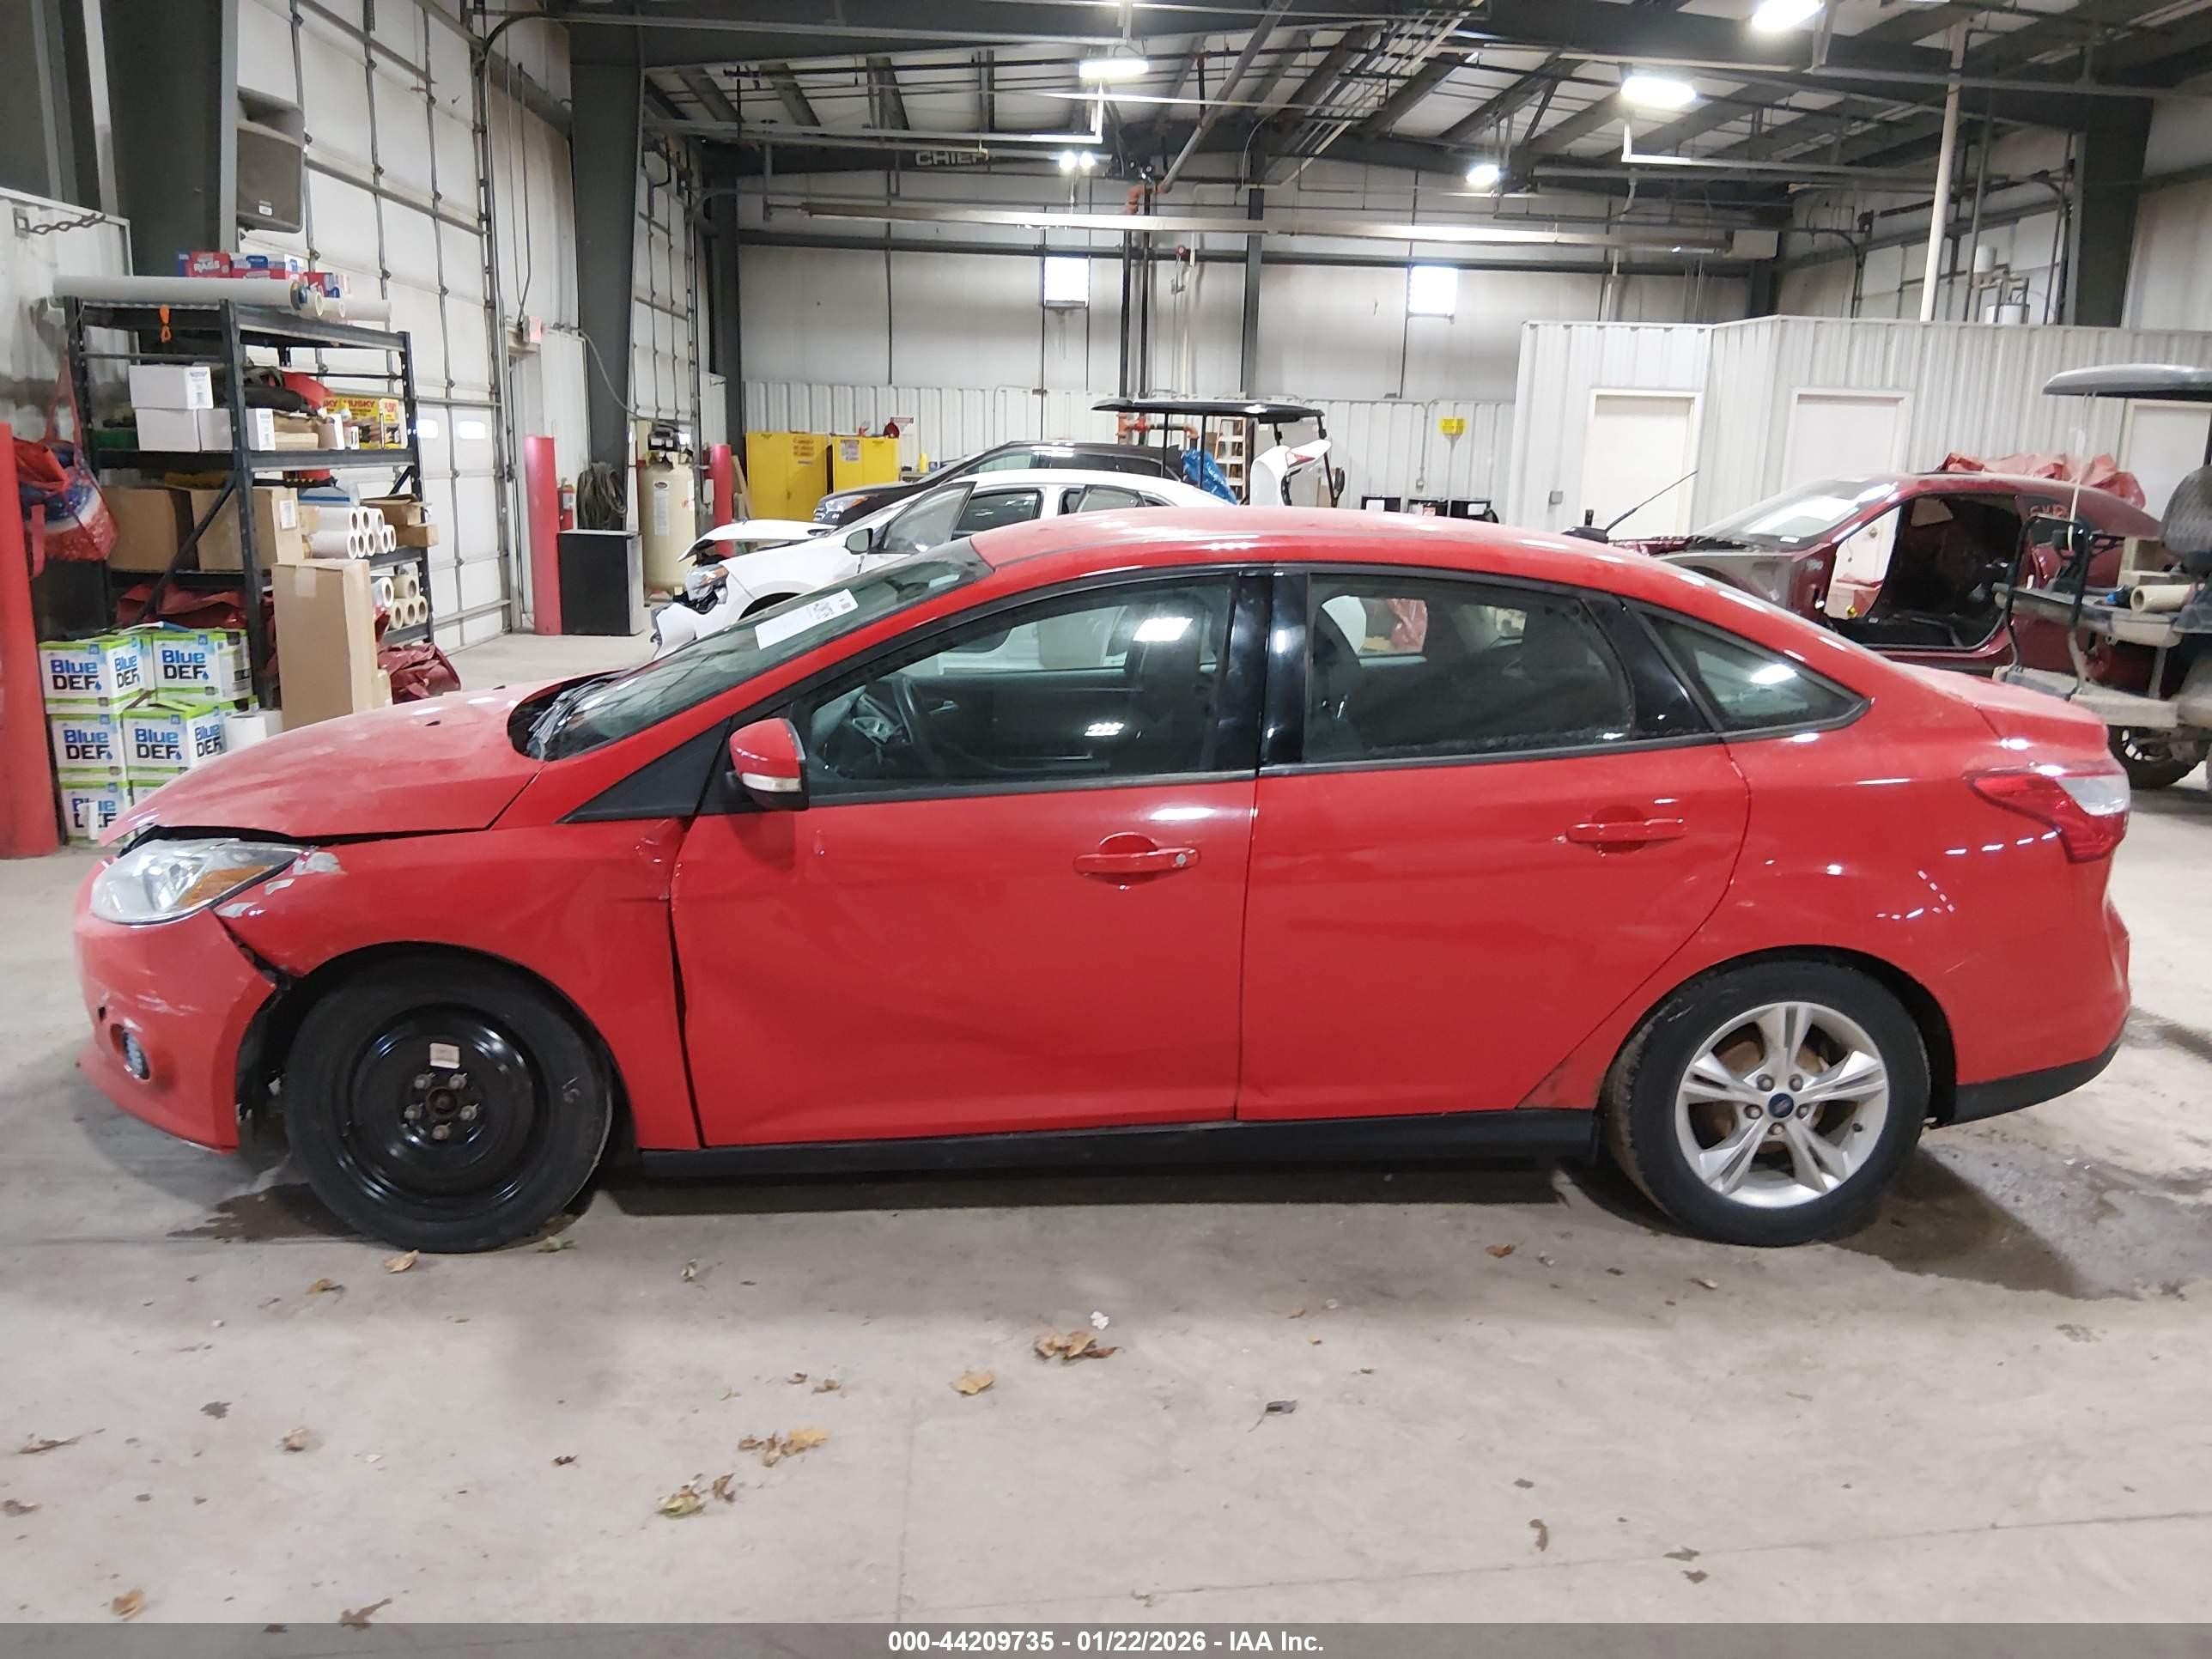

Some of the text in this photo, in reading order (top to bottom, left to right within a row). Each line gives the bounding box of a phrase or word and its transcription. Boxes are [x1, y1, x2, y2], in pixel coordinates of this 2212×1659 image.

[114, 655, 137, 672] Blue
[161, 649, 206, 664] Blue
[51, 659, 98, 673] Blue
[163, 665, 207, 679] DEF
[52, 675, 100, 690] DEF
[117, 668, 138, 689] DEF
[64, 730, 109, 744] Blue
[134, 728, 179, 743] Blue
[194, 725, 221, 741] Blue
[65, 744, 111, 760] DEF
[137, 744, 179, 759] DEF
[196, 736, 223, 758] DEF
